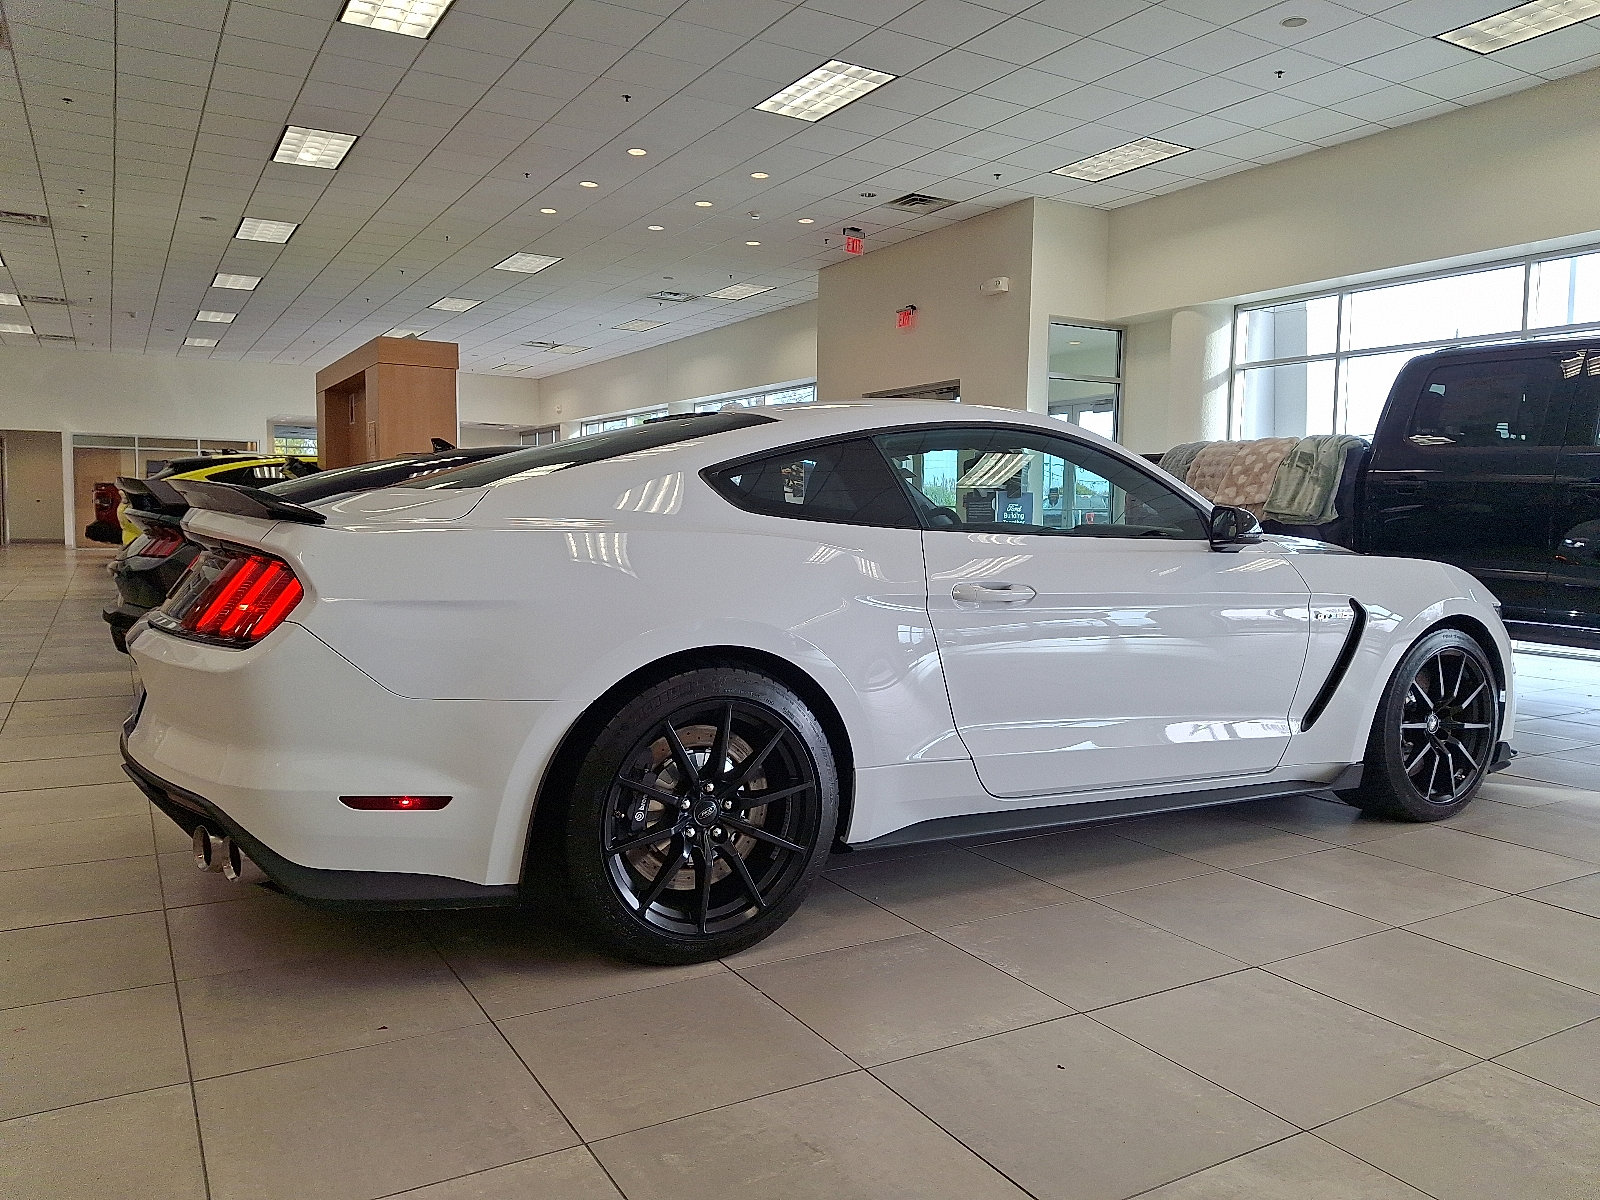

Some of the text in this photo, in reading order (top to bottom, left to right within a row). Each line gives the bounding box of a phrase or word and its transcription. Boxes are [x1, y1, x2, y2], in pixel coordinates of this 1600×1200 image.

[847, 237, 861, 254] EXIT
[1007, 504, 1022, 512] Ford
[1004, 512, 1024, 520] Building
